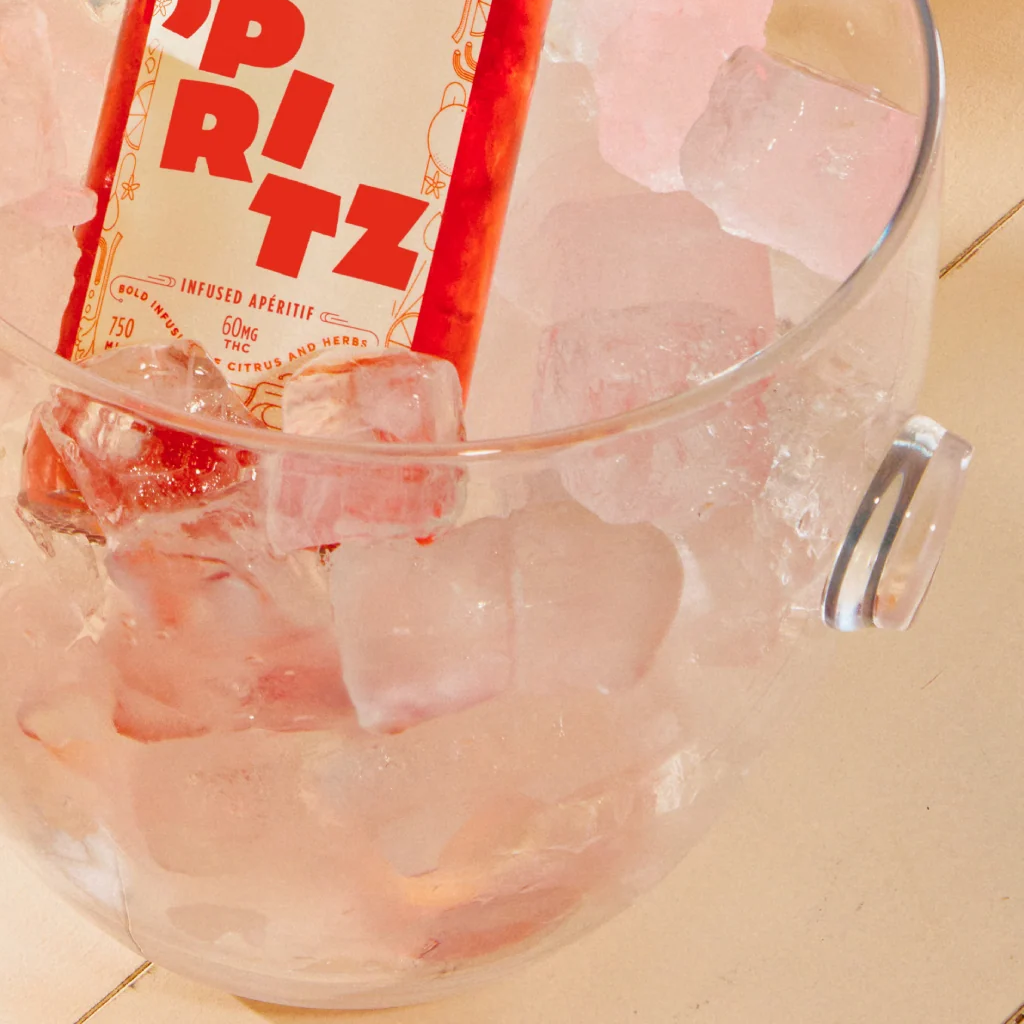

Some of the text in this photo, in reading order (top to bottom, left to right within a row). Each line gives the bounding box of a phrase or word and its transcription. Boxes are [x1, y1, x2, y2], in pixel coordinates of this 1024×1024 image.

[180, 278, 314, 321] INFUSED APÉRITIF
[108, 316, 135, 338] 750
[118, 284, 148, 302] BOLD
[227, 358, 282, 373] CITRUS
[288, 343, 316, 362] AND
[322, 336, 368, 348] HERBS
[222, 316, 259, 342] 60MG
[224, 339, 250, 354] THC
